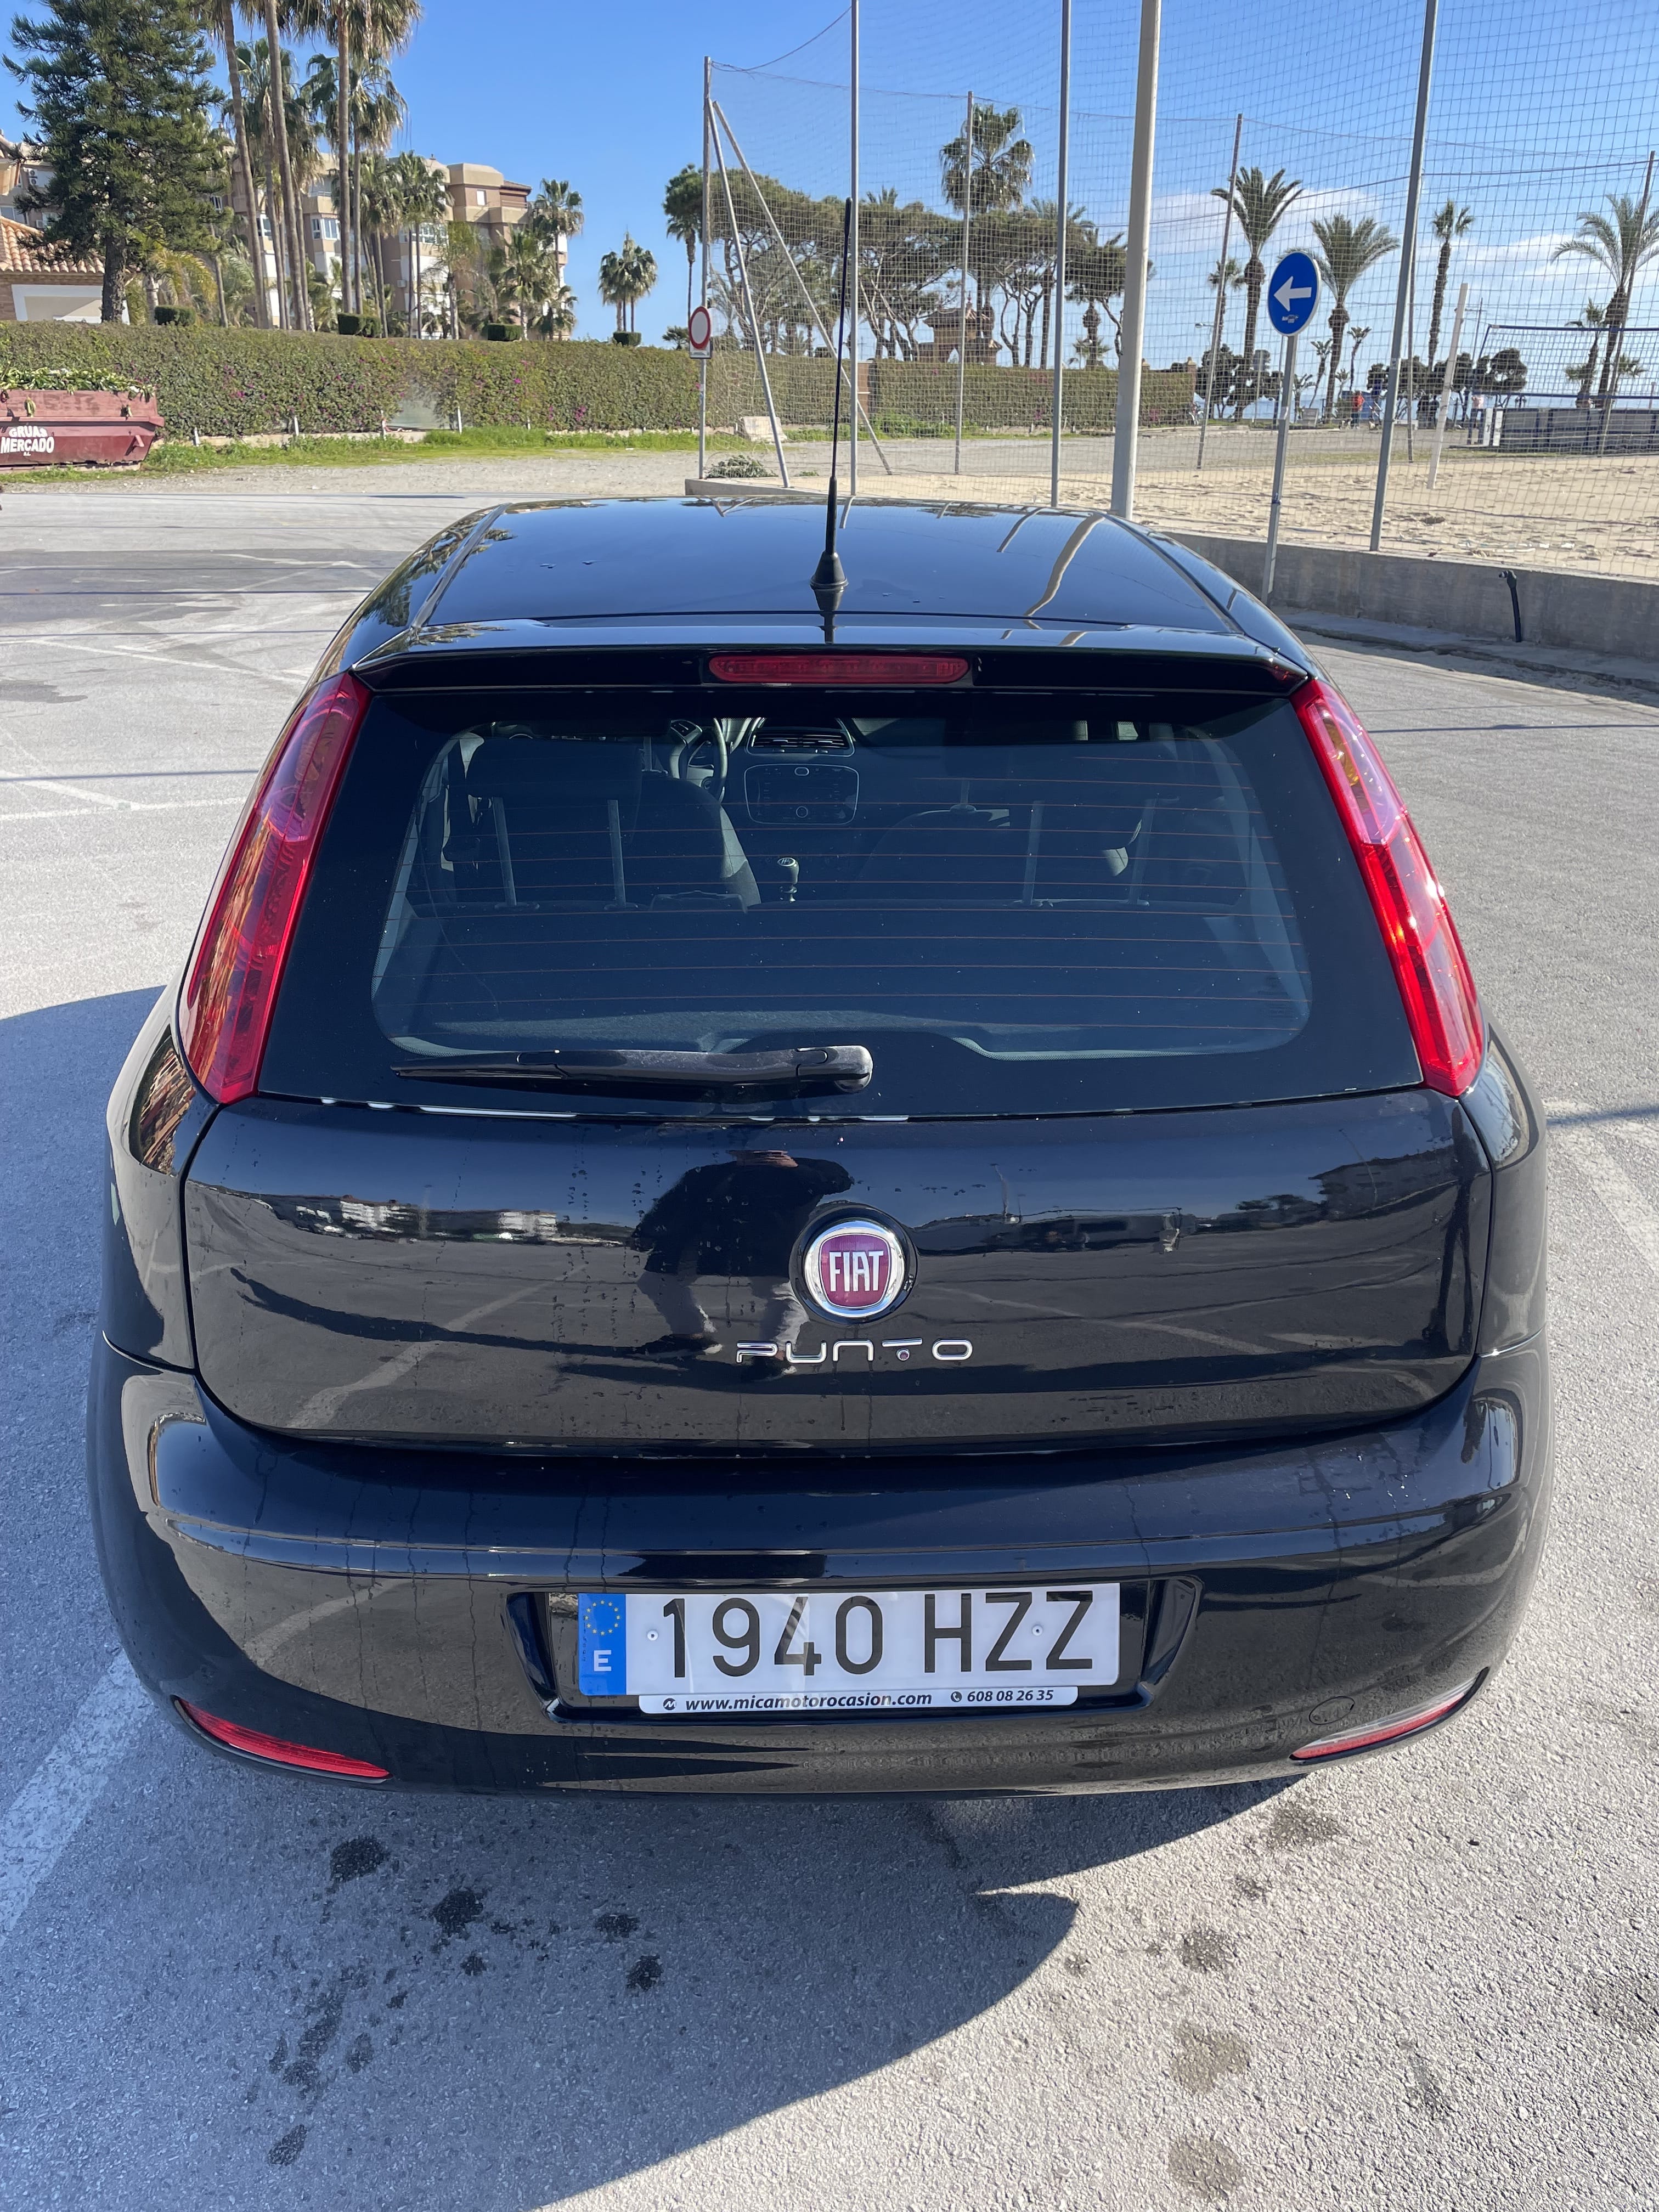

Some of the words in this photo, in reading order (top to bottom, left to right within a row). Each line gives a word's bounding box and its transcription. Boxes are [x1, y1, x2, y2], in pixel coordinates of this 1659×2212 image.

[9, 425, 48, 437] GRUAS
[1, 437, 55, 454] MERCADO
[828, 1250, 884, 1292] FIAT
[736, 1338, 973, 1363] PUNTO
[663, 1595, 884, 1678] 1940
[924, 1590, 1093, 1674] HZZ
[594, 1650, 612, 1672] E
[685, 1691, 932, 1711] www.micamotorocasion.com
[967, 1690, 993, 1702] 608
[996, 1690, 1013, 1701] 08
[1016, 1690, 1034, 1701] 26
[1036, 1689, 1054, 1700] 35
